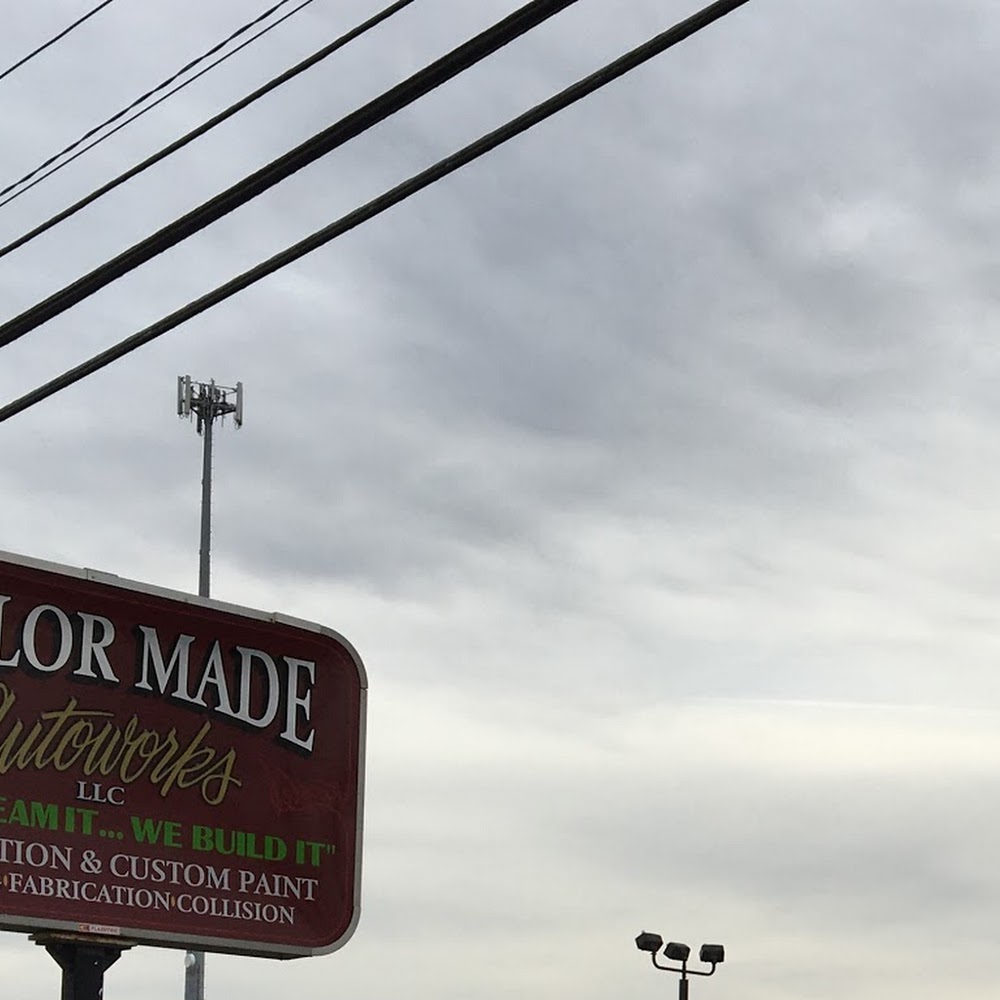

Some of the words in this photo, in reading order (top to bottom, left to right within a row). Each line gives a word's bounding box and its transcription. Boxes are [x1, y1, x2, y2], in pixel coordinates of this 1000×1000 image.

[0, 595, 119, 683] LOR
[135, 625, 315, 752] MADE
[77, 780, 125, 805] LLC
[131, 815, 182, 848] WE
[192, 825, 287, 861] BUILD
[0, 838, 72, 871] TION
[80, 849, 102, 874] &
[110, 853, 230, 891] CUSTOM
[238, 870, 318, 901] PAINT
[9, 872, 171, 911] FABRICATION
[177, 894, 295, 925] COLLISION
